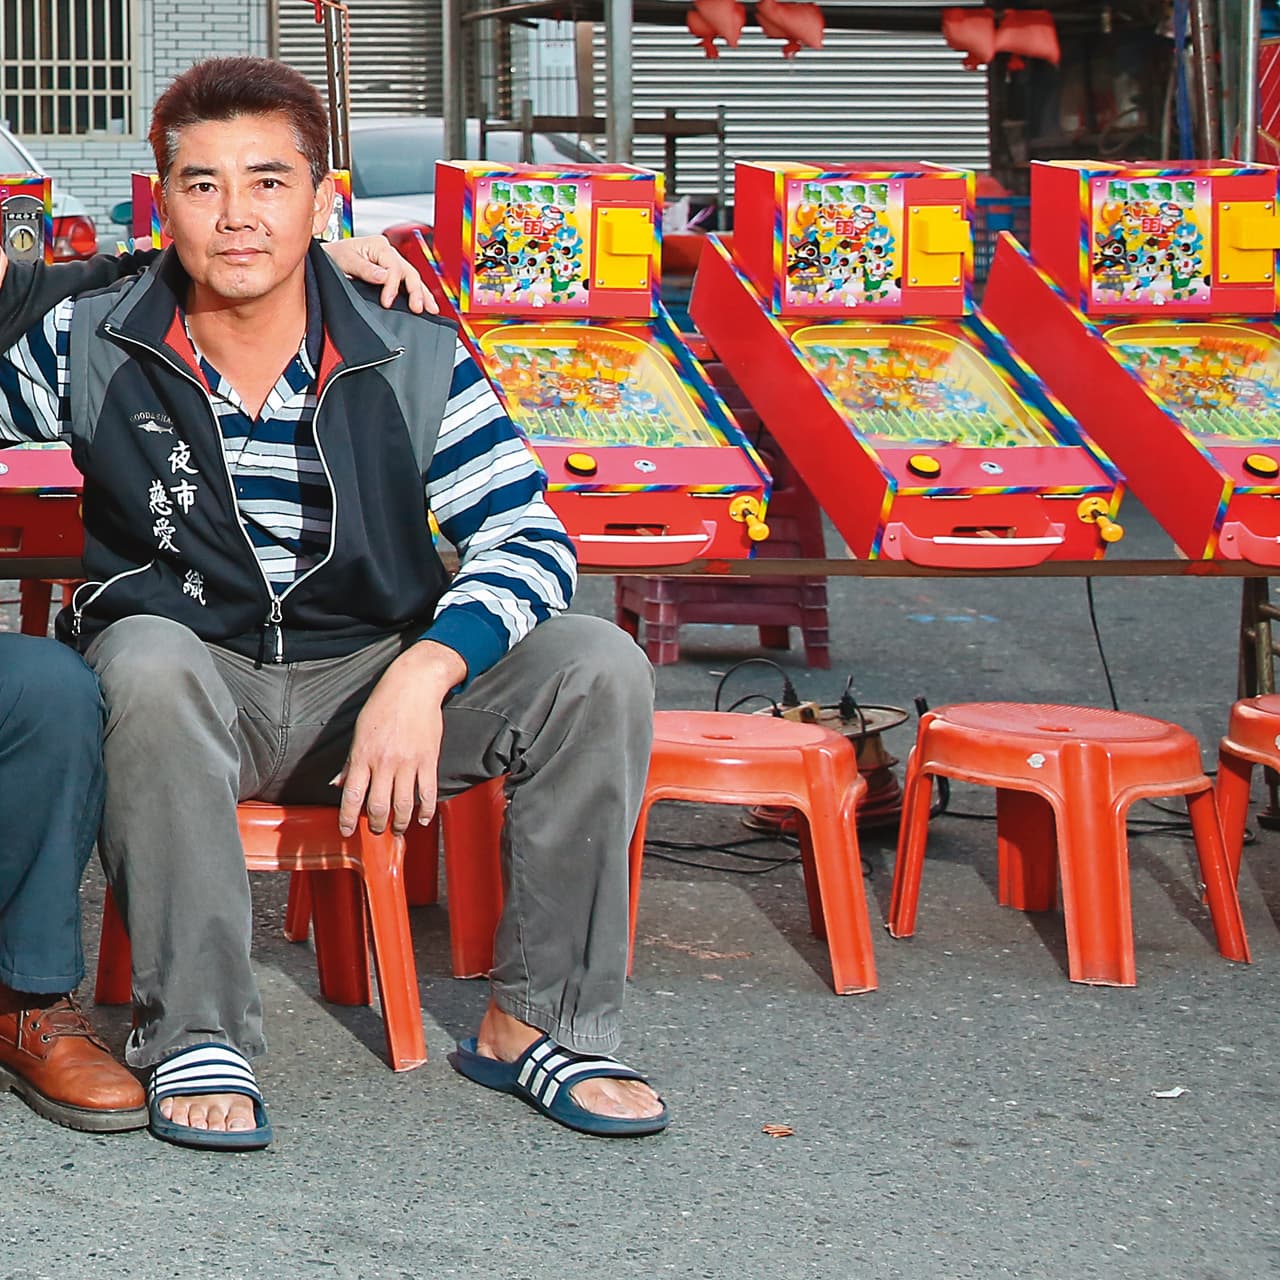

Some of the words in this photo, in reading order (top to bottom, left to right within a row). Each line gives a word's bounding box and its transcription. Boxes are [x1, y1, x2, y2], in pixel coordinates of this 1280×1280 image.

[524, 221, 542, 234] 33
[836, 221, 854, 234] 33
[1143, 219, 1161, 232] 33
[168, 440, 199, 515] 夜市
[148, 479, 206, 606] 慈愛織
